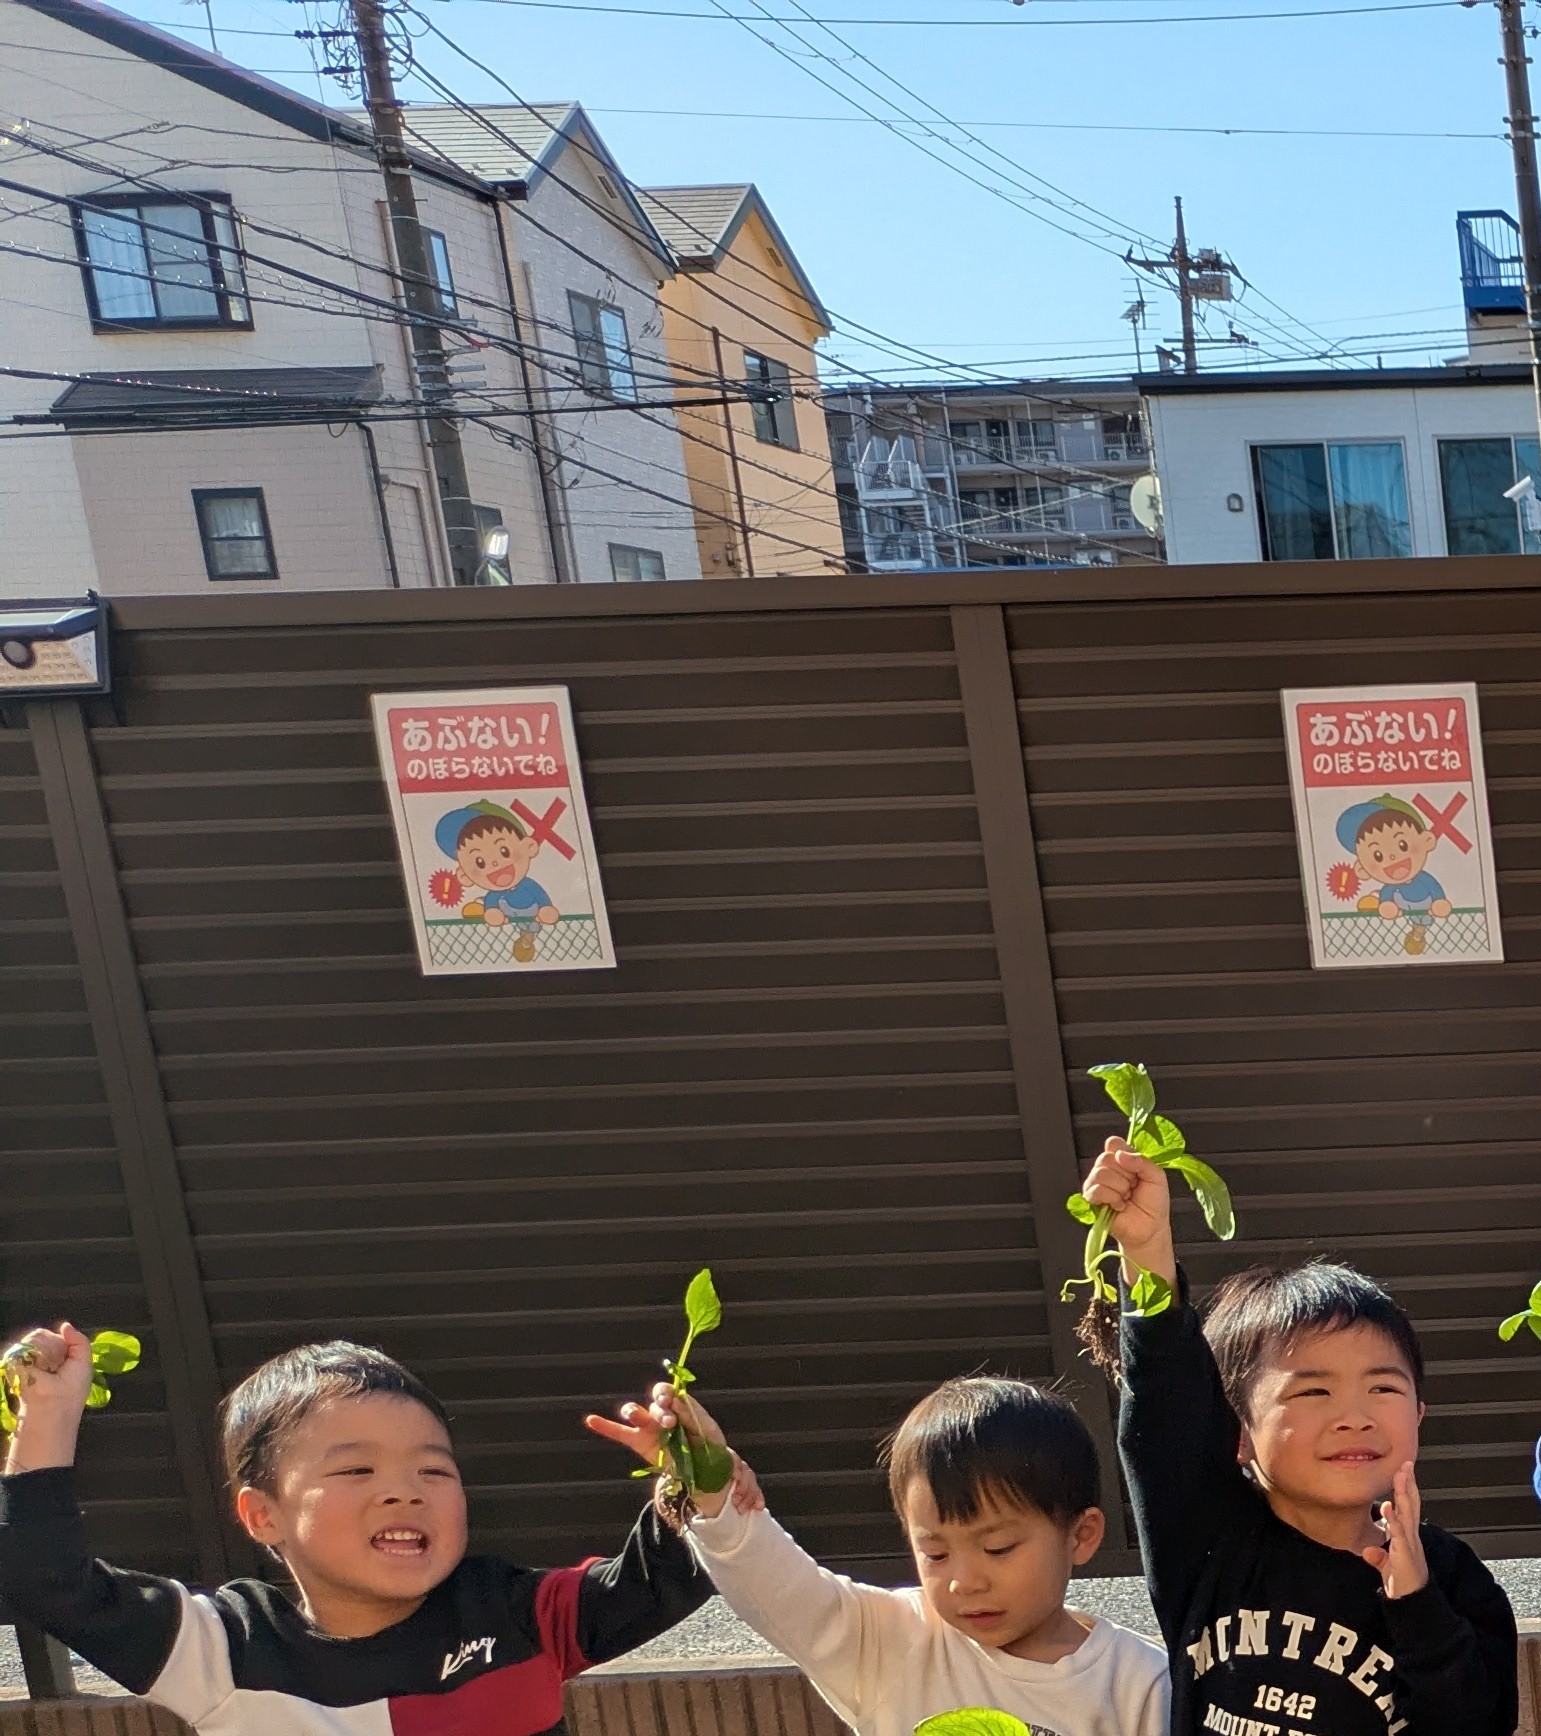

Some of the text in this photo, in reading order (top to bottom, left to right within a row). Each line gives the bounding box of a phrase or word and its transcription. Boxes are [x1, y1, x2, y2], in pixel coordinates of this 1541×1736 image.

[401, 713, 550, 752] あぶない!
[1309, 708, 1457, 747] あぶない!
[1312, 748, 1462, 775] のぼらないでね
[1254, 1684, 1317, 1720] 1642
